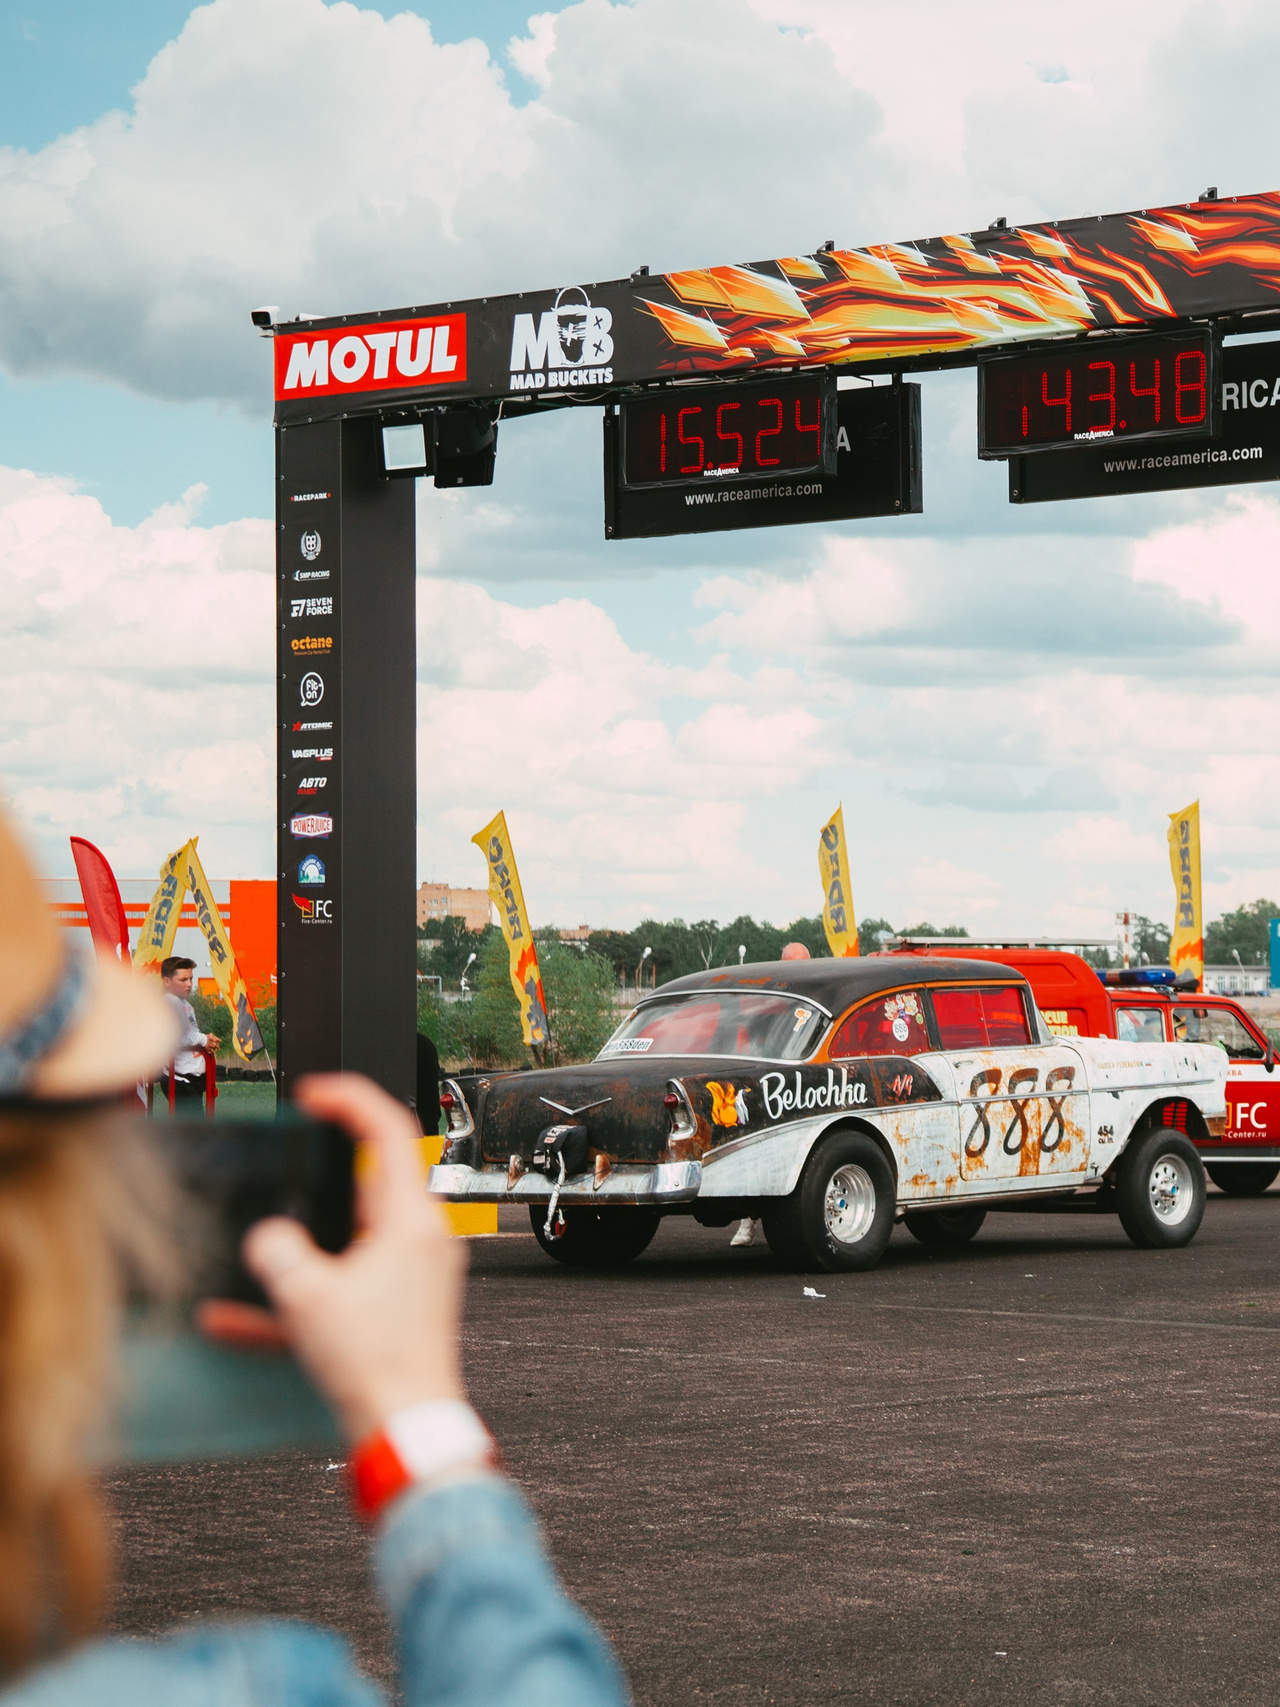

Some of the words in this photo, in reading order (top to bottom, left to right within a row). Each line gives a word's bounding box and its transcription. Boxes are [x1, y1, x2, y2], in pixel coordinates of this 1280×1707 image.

[284, 325, 457, 390] MOTUL
[510, 374, 546, 390] MAD
[548, 368, 614, 387] BUCKETS
[659, 398, 821, 473] 15.524
[1104, 445, 1263, 473] www.raceamerica.com
[294, 492, 328, 501] RACEPARK
[685, 482, 823, 506] www.raceamerica.com
[311, 570, 330, 578] RACING
[306, 597, 333, 607] SEVEN
[306, 606, 333, 616] FORCE
[291, 636, 333, 650] octane
[292, 748, 333, 758] VAGPLUS
[299, 777, 327, 788] АВТО
[293, 817, 330, 834] POWERJUICE
[316, 900, 333, 918] FC
[759, 1068, 868, 1120] Belochka
[965, 1067, 1075, 1158] 888
[1236, 1102, 1267, 1129] FC
[1098, 1125, 1114, 1137] 454
